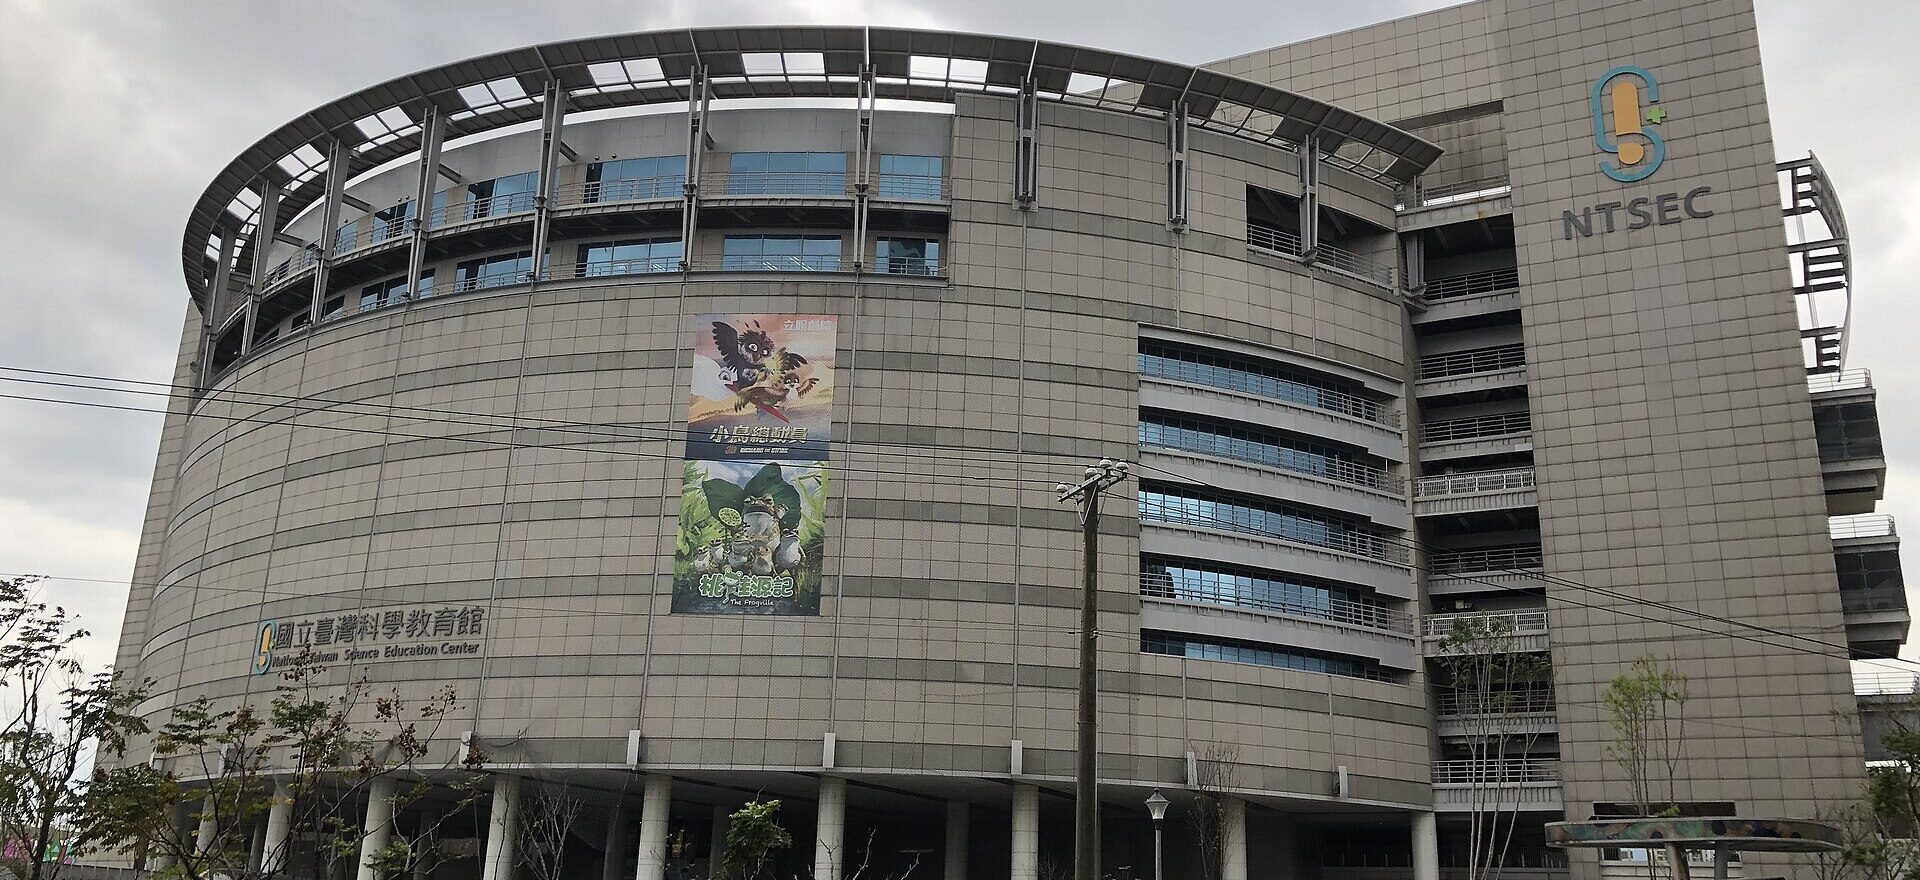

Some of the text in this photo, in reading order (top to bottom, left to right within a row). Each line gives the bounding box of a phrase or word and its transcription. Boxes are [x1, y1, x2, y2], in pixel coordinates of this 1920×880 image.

[1562, 185, 1714, 241] NTSEC
[744, 599, 774, 608] Frogville
[275, 605, 485, 650] 國立臺灣科學教育館
[344, 648, 380, 661] Science
[384, 643, 438, 658] Education
[440, 641, 480, 655] Center
